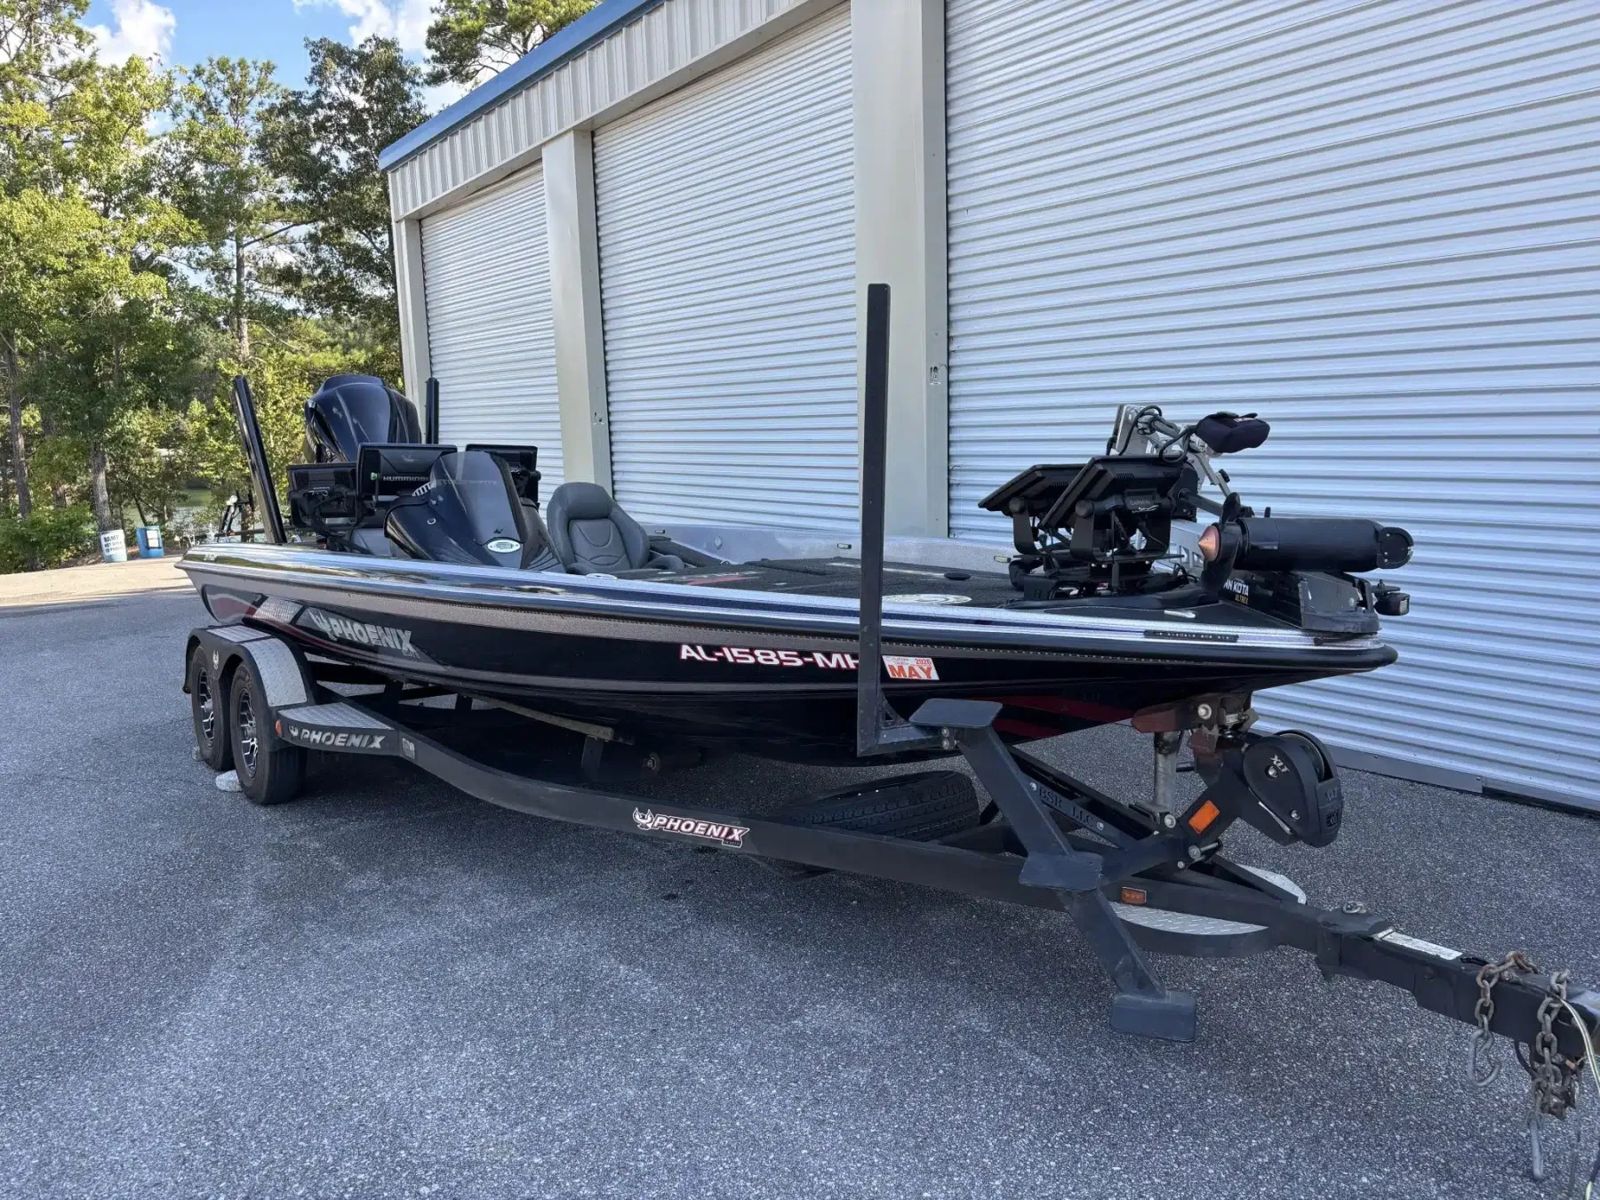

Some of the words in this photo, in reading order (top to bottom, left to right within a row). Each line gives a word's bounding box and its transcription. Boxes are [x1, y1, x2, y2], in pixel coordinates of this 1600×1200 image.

[1233, 581, 1249, 597] KOTA
[328, 618, 413, 652] PHOENIX
[888, 664, 932, 679] MAY
[300, 729, 385, 749] PHOENIX
[1270, 754, 1290, 774] XLT
[653, 816, 744, 841] PHOENIX
